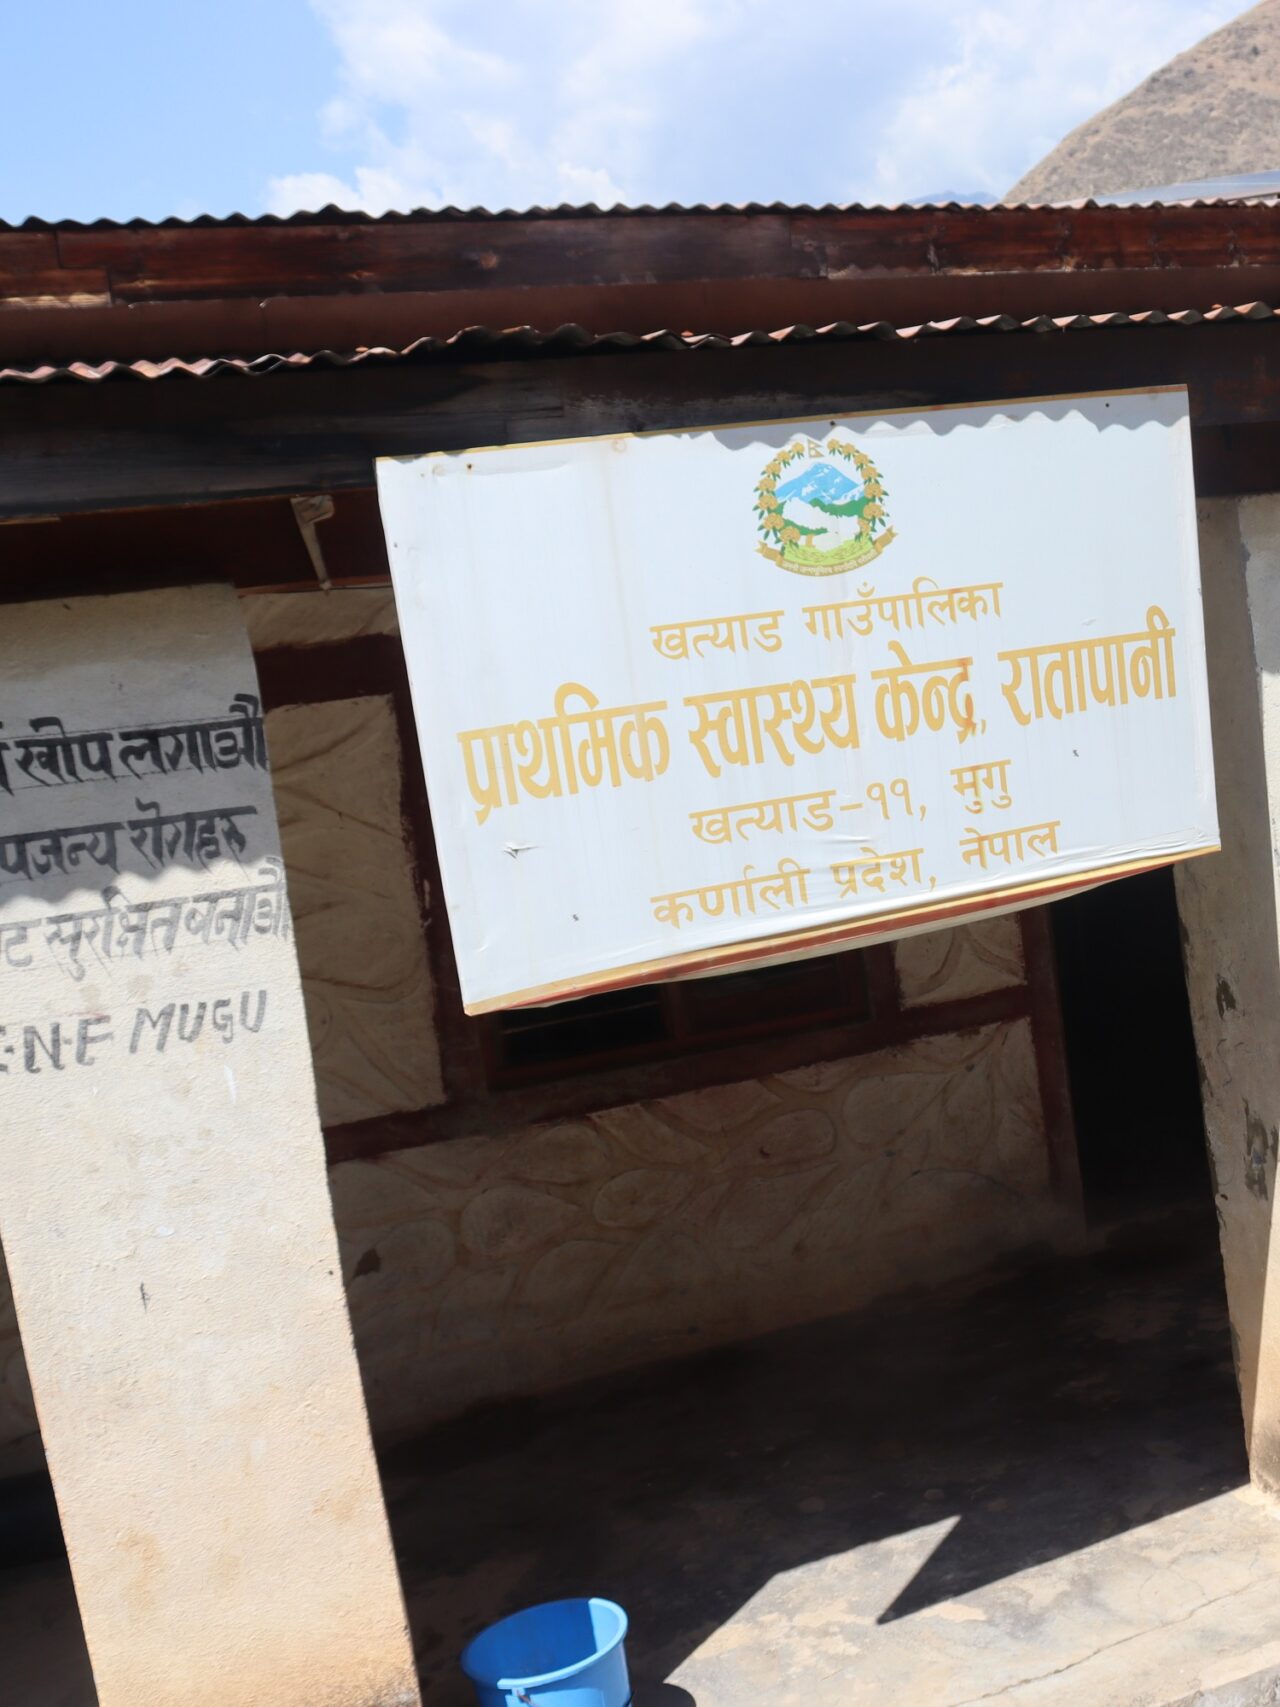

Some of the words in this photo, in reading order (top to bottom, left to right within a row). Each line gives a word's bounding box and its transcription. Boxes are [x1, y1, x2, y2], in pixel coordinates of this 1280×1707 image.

[649, 609, 785, 660] खत्याड
[802, 576, 1004, 641] गाउँपालिका
[15, 717, 117, 786] खोप
[456, 682, 670, 826] प्राथमिक
[683, 673, 860, 778] स्वास्थ्य
[871, 640, 987, 745] केन्द्र,
[997, 604, 1177, 727] रातापानी
[950, 759, 1013, 815] मुगु
[650, 858, 811, 930] कर्णाली
[830, 847, 937, 899] प्रदेश,
[959, 820, 1062, 871] नेपाल
[129, 989, 267, 1053] MUGU
